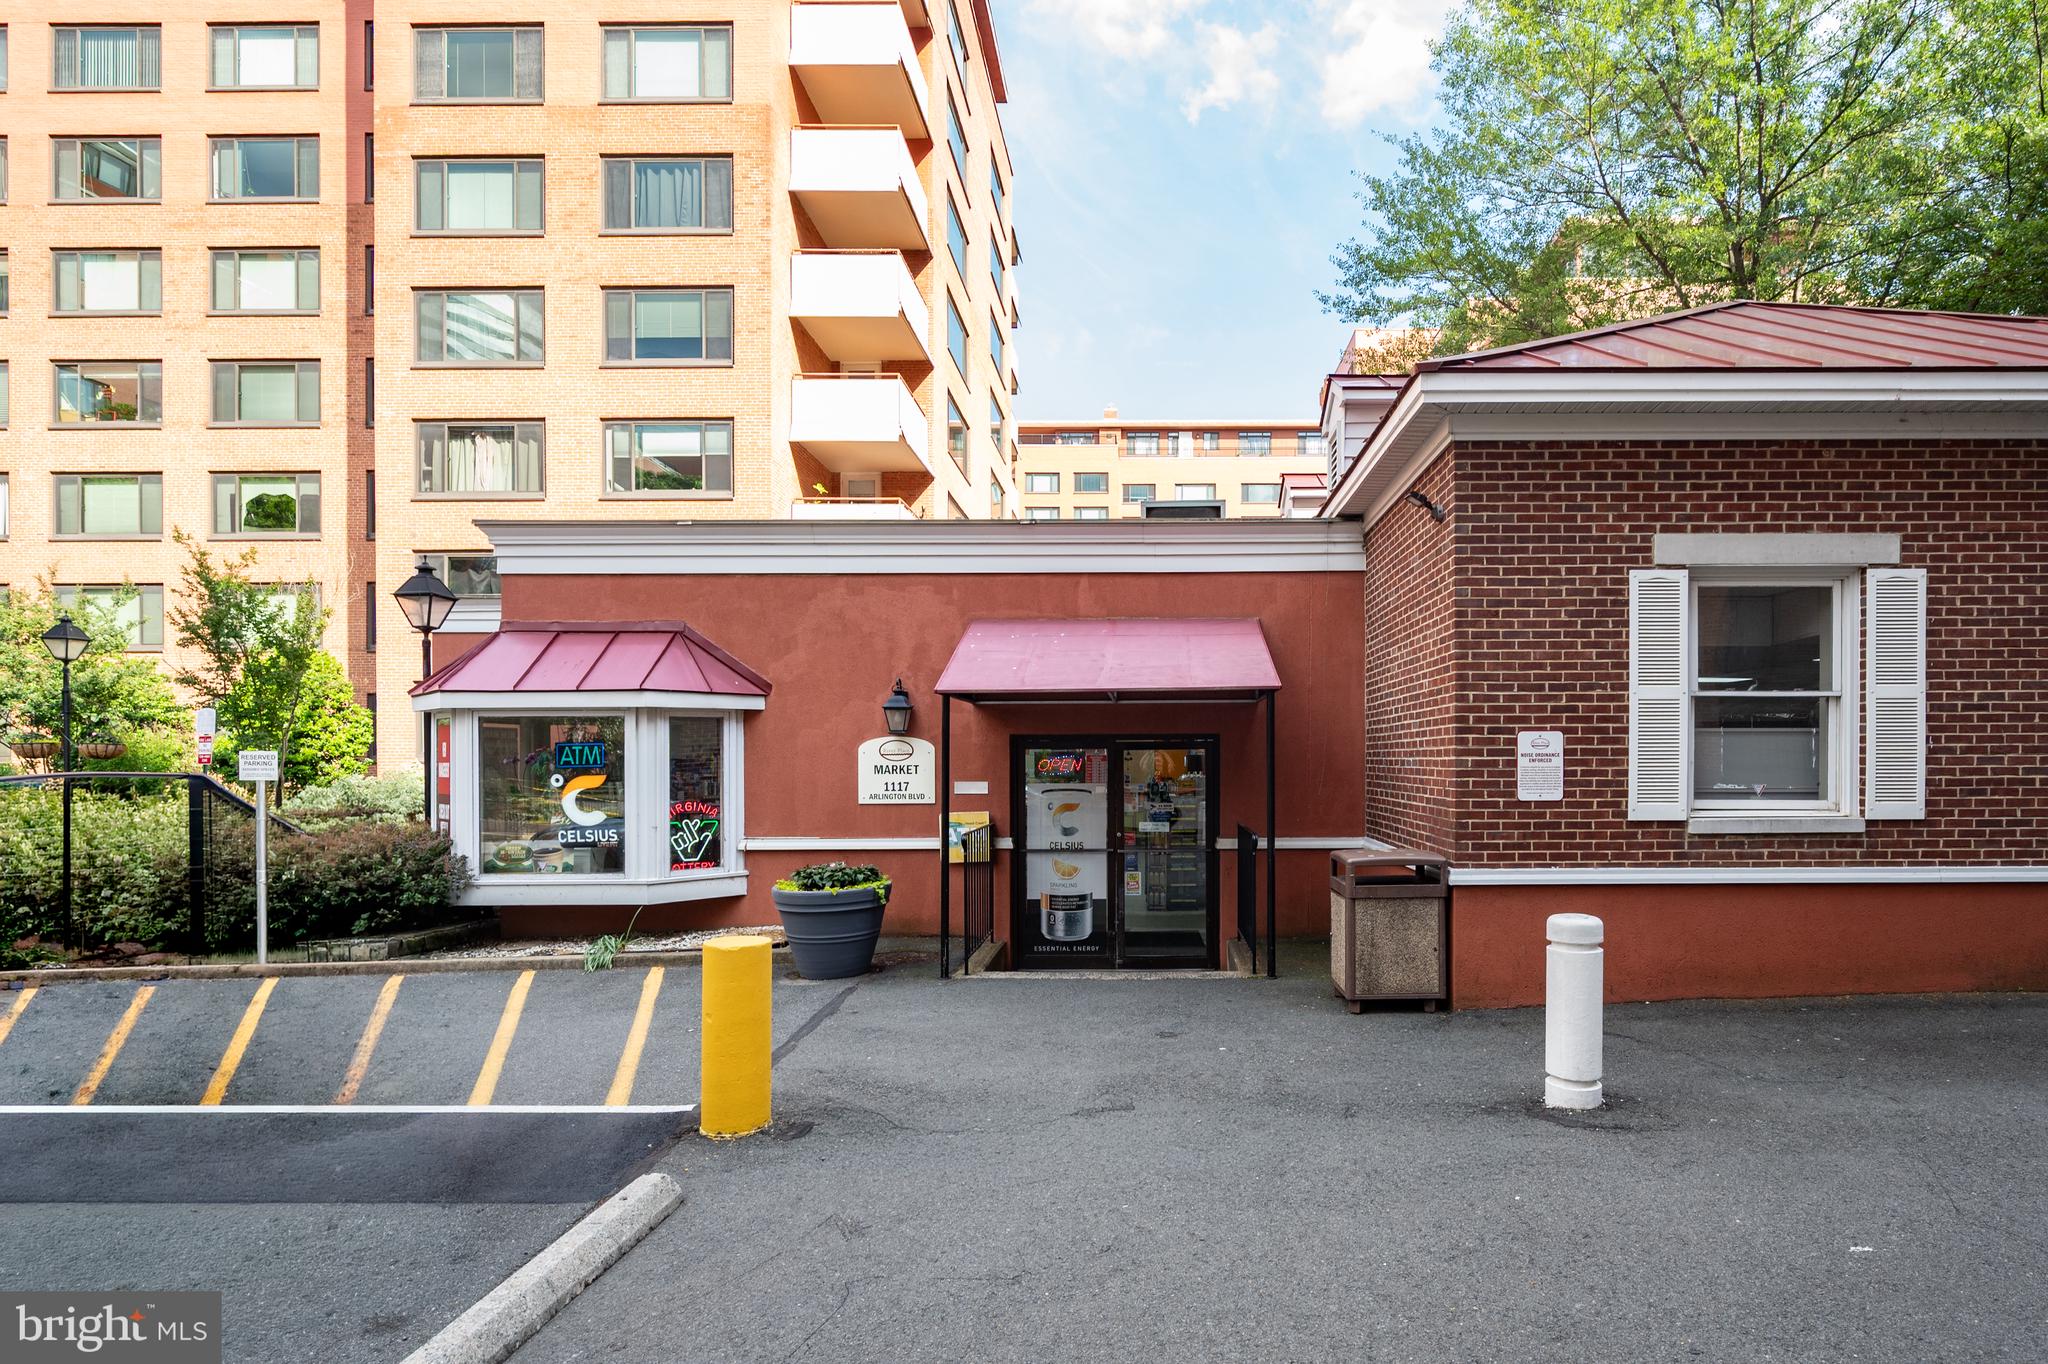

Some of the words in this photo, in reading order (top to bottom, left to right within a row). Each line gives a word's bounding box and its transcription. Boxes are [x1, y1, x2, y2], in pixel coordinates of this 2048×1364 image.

[560, 746, 601, 765] ATM
[873, 764, 920, 775] MARKET
[1037, 758, 1083, 772] OPEN
[884, 781, 910, 792] 1117
[669, 801, 719, 819] IRGINIA
[558, 829, 618, 843] CELSIUS
[1049, 841, 1084, 850] CELSIUS
